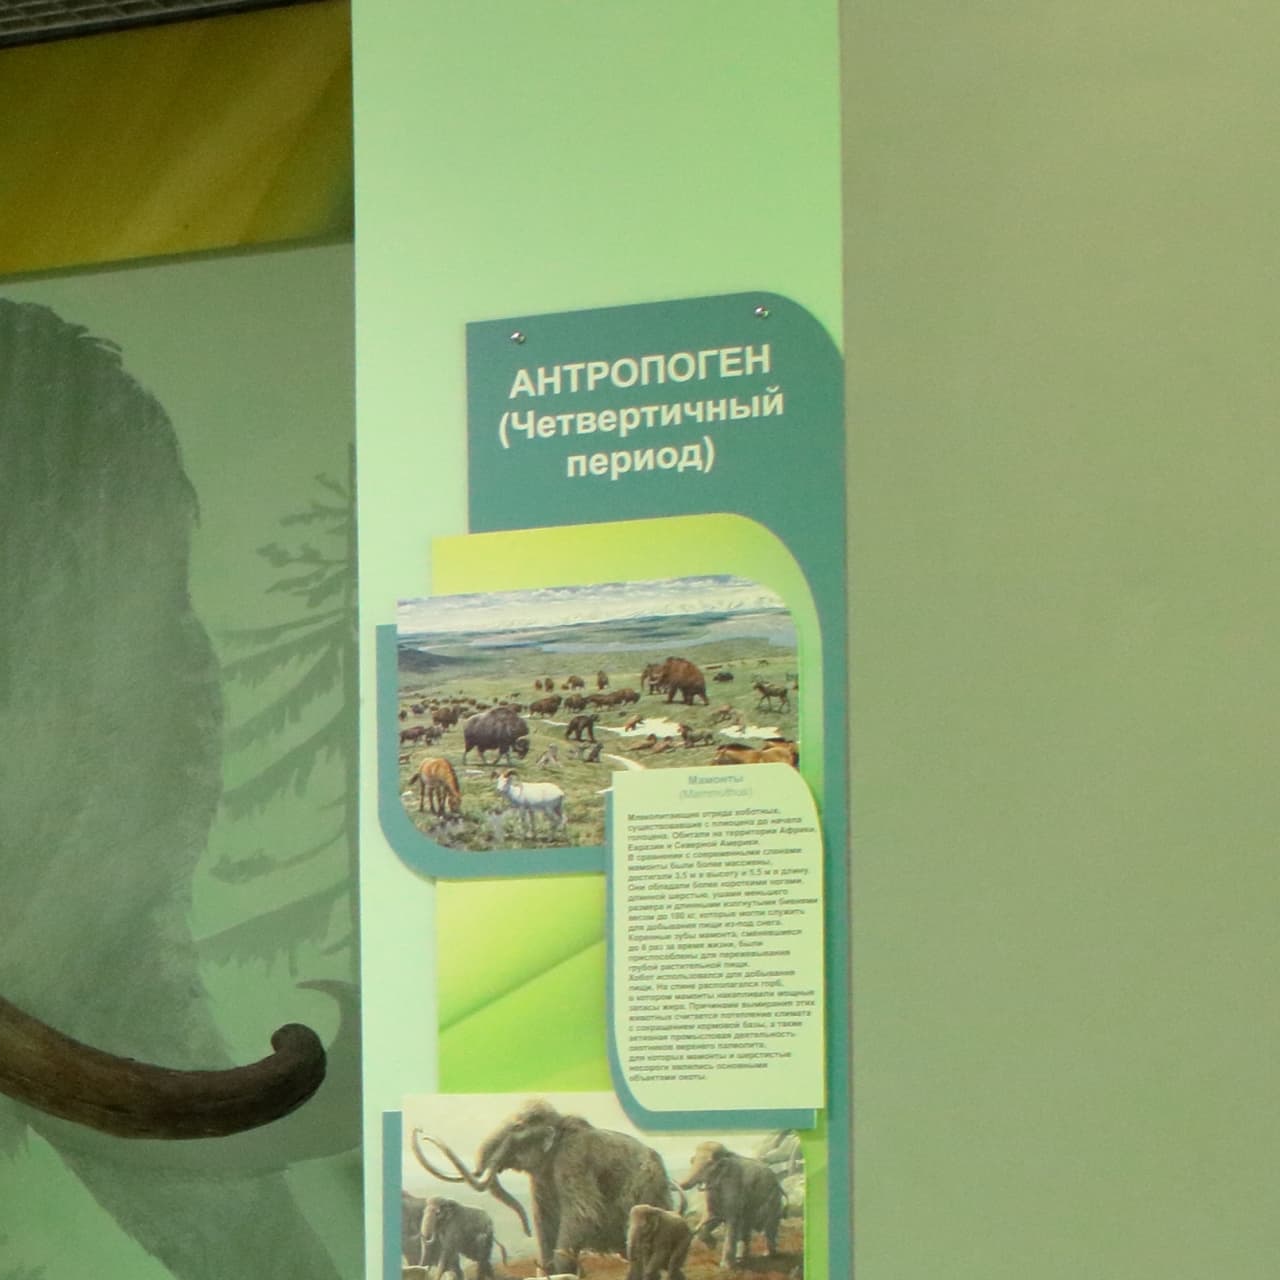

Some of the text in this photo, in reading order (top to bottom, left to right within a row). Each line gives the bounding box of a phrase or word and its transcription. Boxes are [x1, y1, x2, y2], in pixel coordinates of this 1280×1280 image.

[509, 344, 771, 399] АНТРОПОГЕН
[498, 385, 785, 449] (Четвертичный
[566, 435, 716, 481] период)
